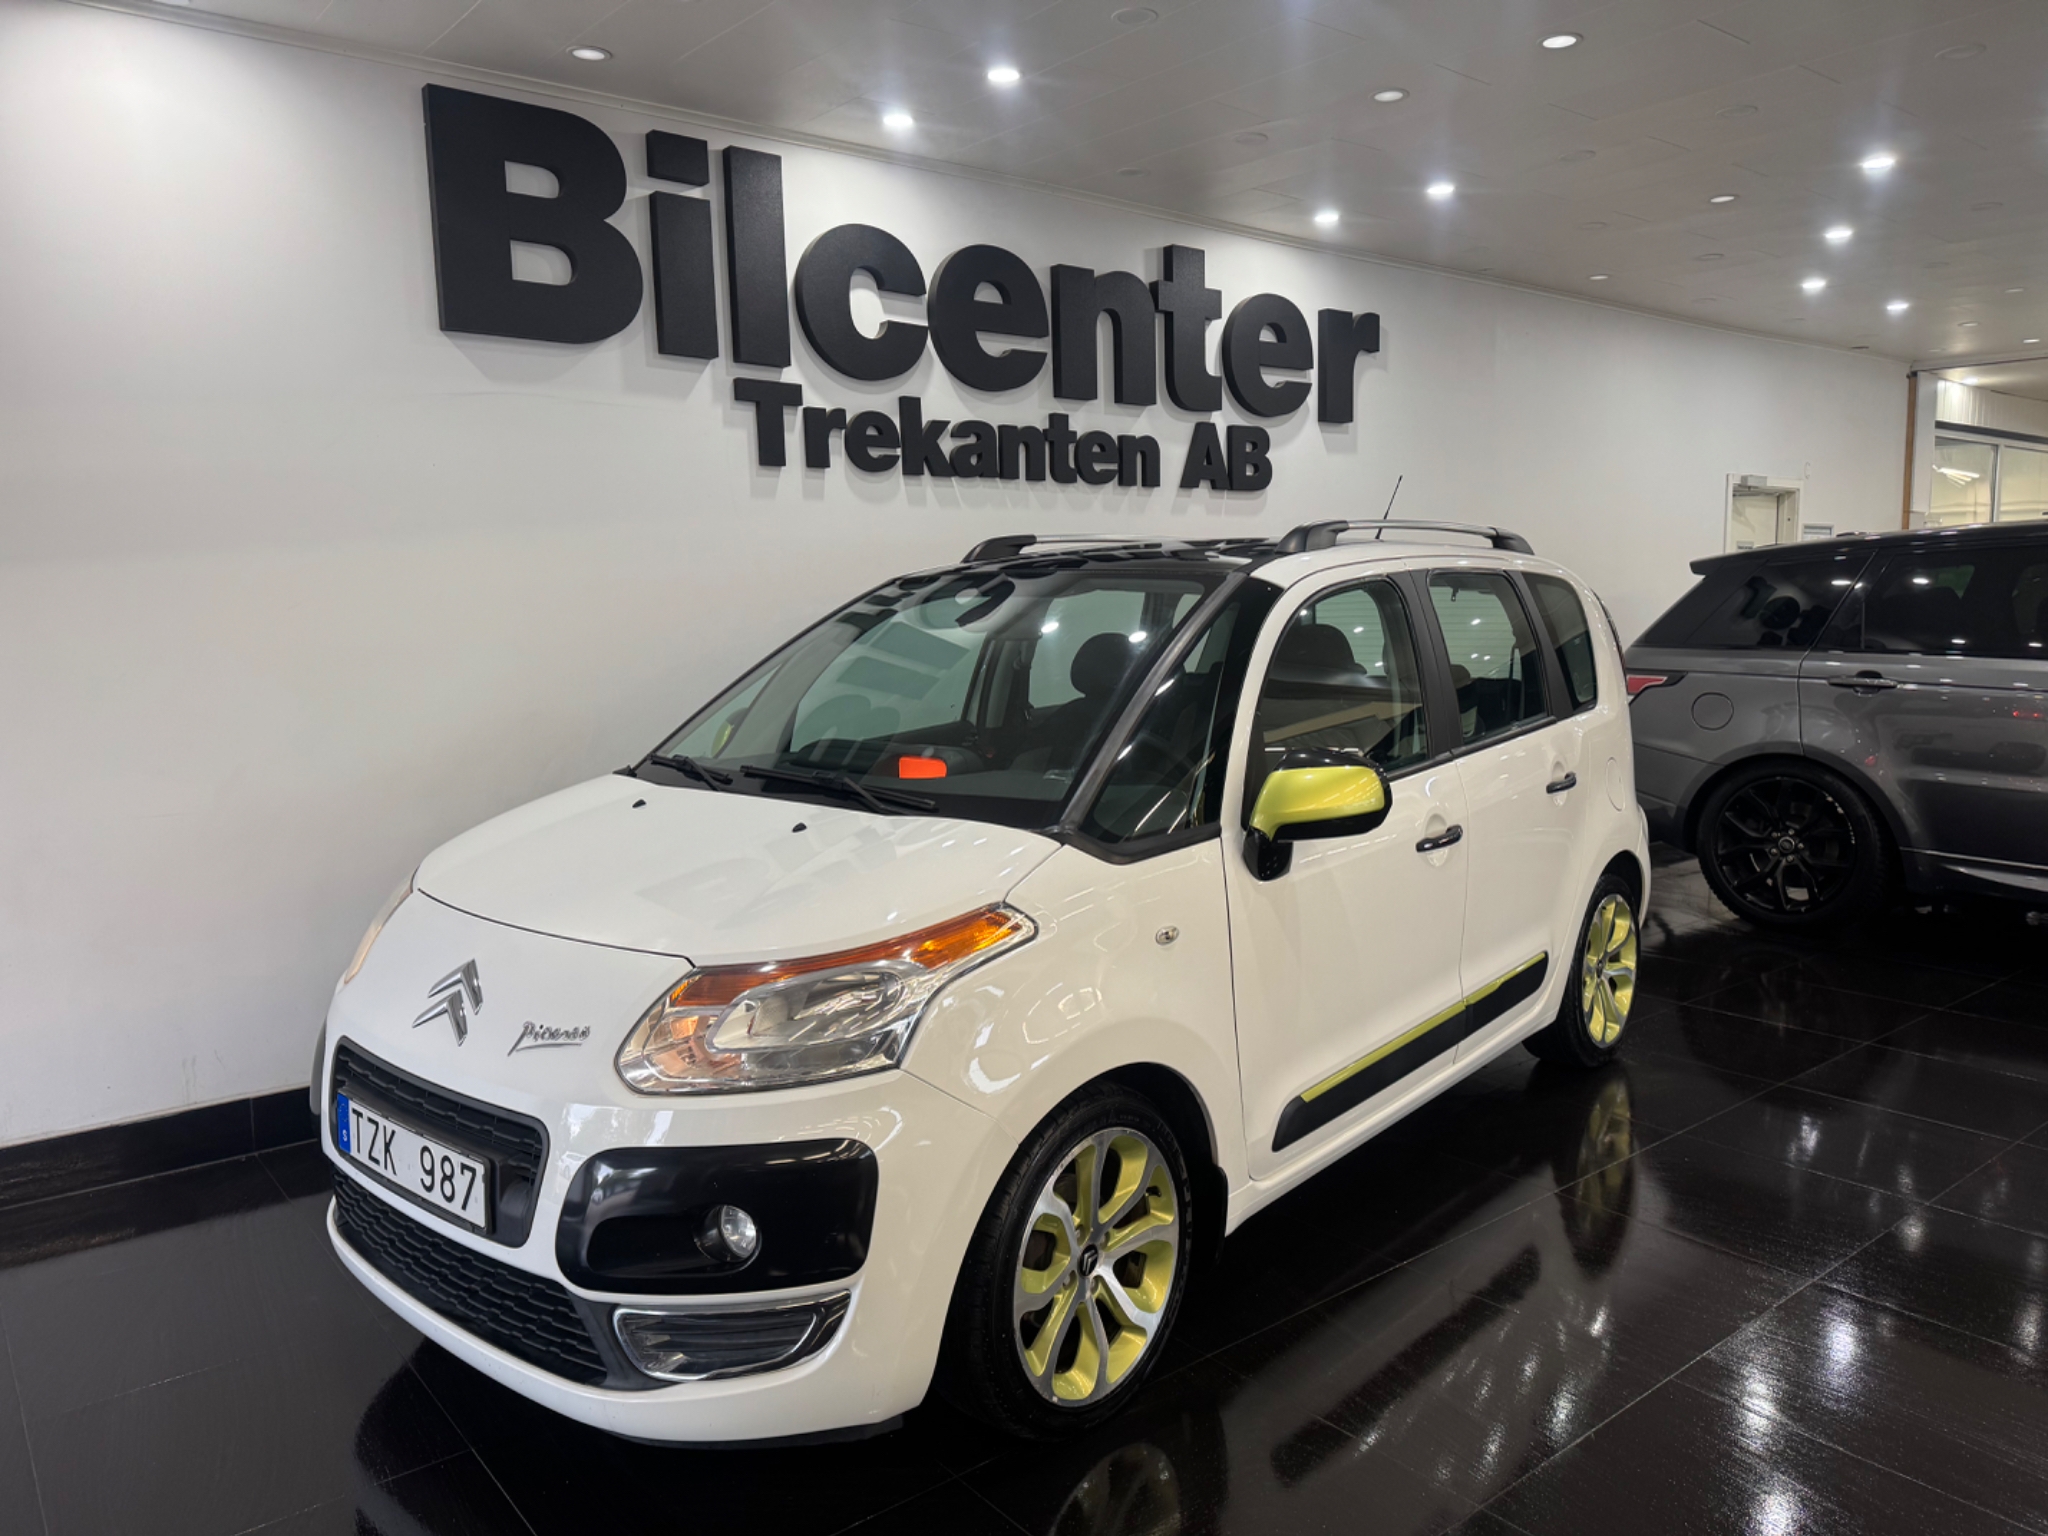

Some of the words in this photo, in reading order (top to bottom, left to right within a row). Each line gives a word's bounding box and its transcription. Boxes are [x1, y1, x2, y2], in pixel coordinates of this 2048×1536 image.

[422, 83, 1380, 423] Bilcenter
[733, 377, 1160, 487] Trekanten
[1180, 421, 1273, 490] AB
[352, 1107, 397, 1176] TZK
[420, 1145, 477, 1212] 987
